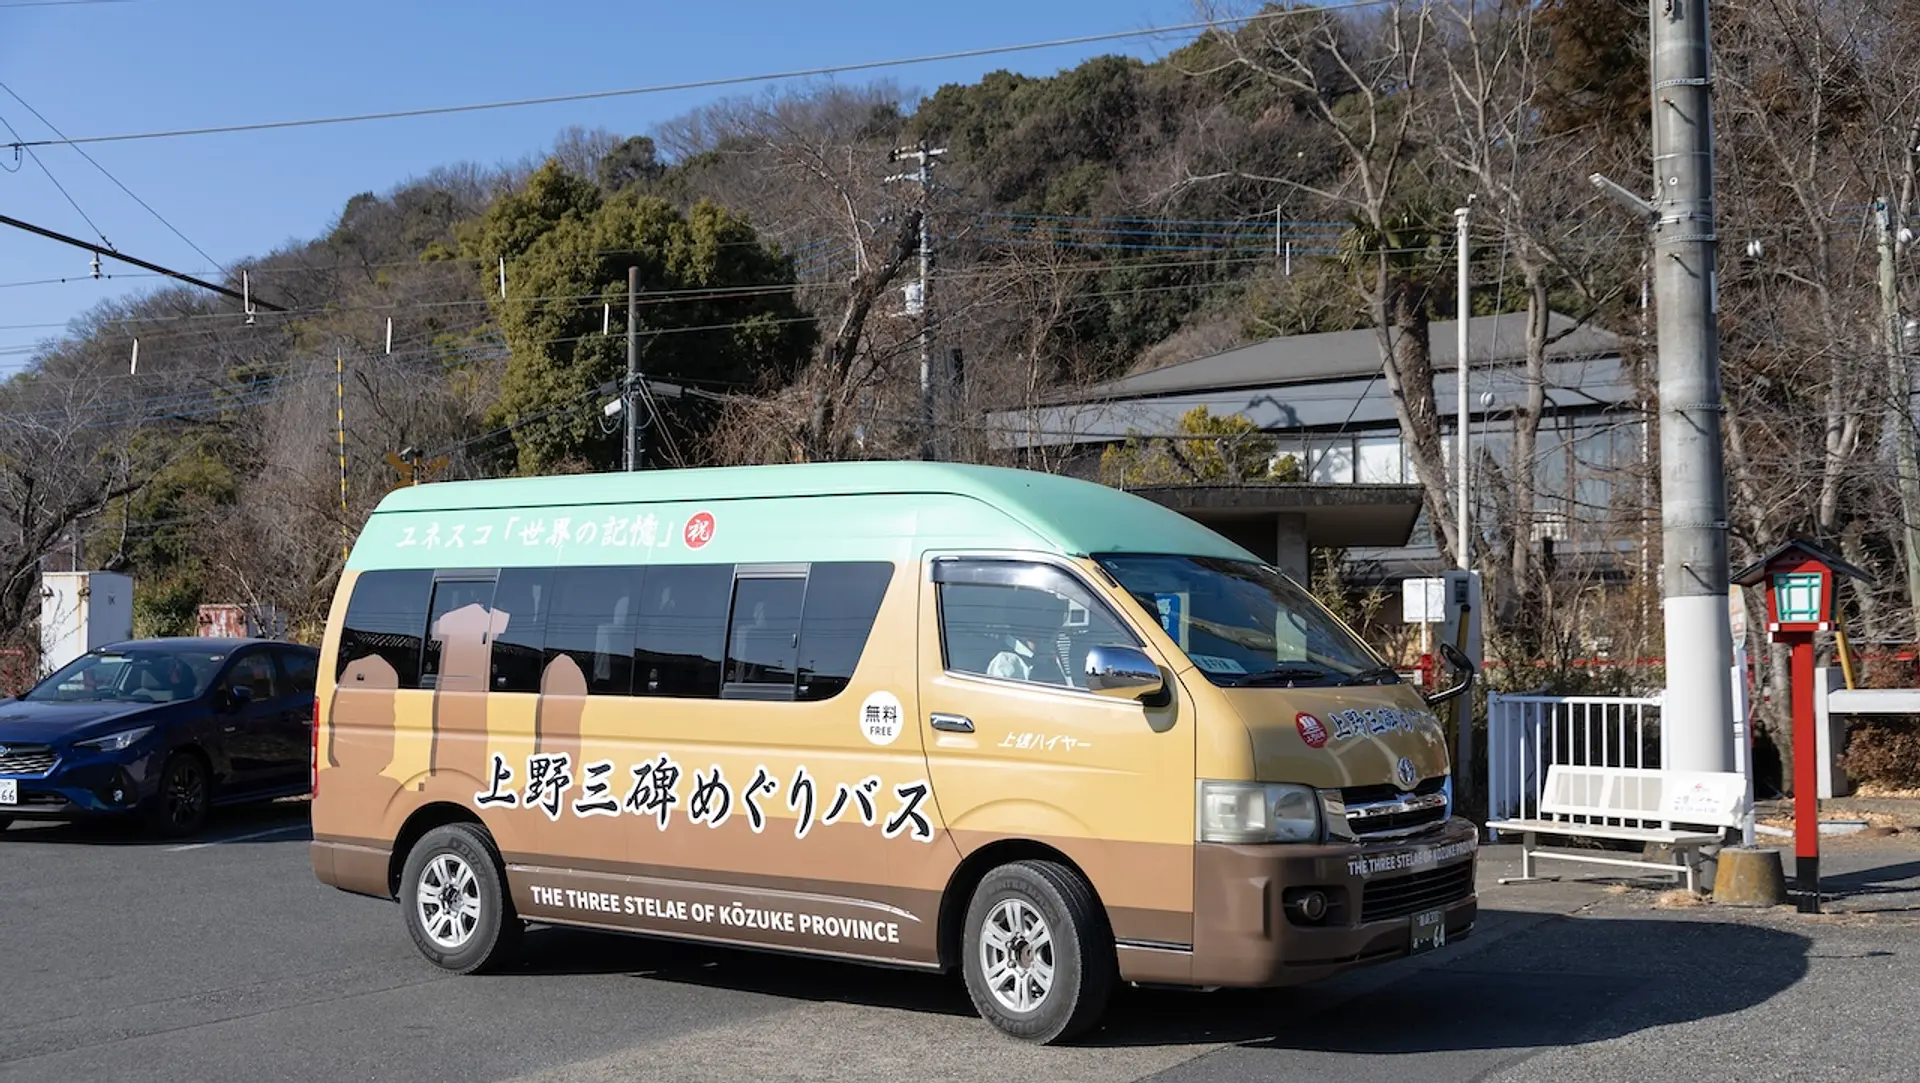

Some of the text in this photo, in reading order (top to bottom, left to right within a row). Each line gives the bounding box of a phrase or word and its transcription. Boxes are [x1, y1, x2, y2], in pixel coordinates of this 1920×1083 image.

[687, 519, 710, 543] 祝
[866, 705, 897, 723] 無料
[870, 726, 892, 736] FREE
[476, 755, 933, 838] 上野三碑めぐりバス
[1348, 860, 1369, 875] THE
[1369, 856, 1395, 872] THREE
[1397, 852, 1422, 868] STELAE
[530, 886, 899, 943] THE THREE STELAE OF KŌZUKE PROVINCE
[1433, 923, 1445, 947] 64
